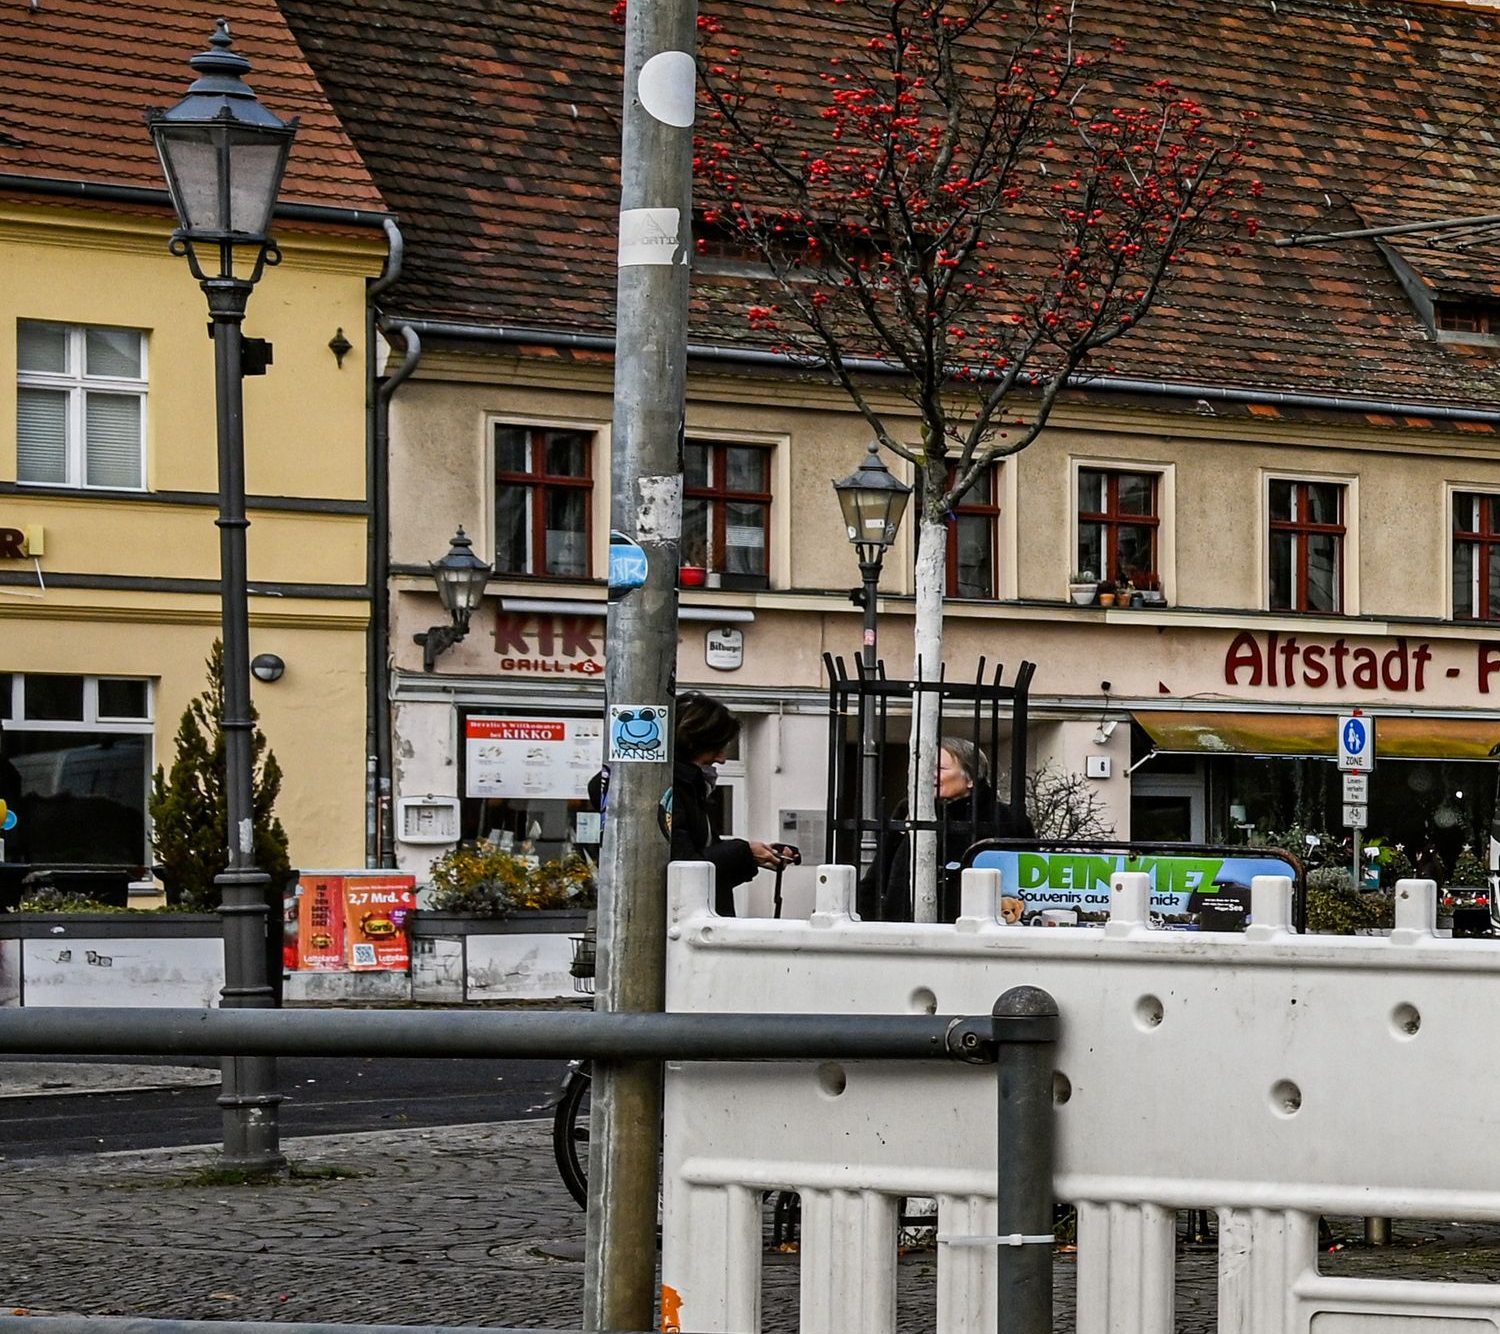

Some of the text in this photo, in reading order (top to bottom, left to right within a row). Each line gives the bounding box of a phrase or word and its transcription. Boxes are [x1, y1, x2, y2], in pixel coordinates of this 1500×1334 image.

[501, 658, 564, 673] GRILL
[1225, 631, 1432, 693] Altstadt
[503, 729, 553, 740] KIKKO
[1345, 756, 1363, 766] ZONE
[1018, 853, 1118, 890] DEIN
[348, 892, 369, 905] 2,7
[371, 892, 399, 903] Mrd.
[1018, 888, 1082, 903] Souvenirs
[1085, 893, 1110, 904] aus
